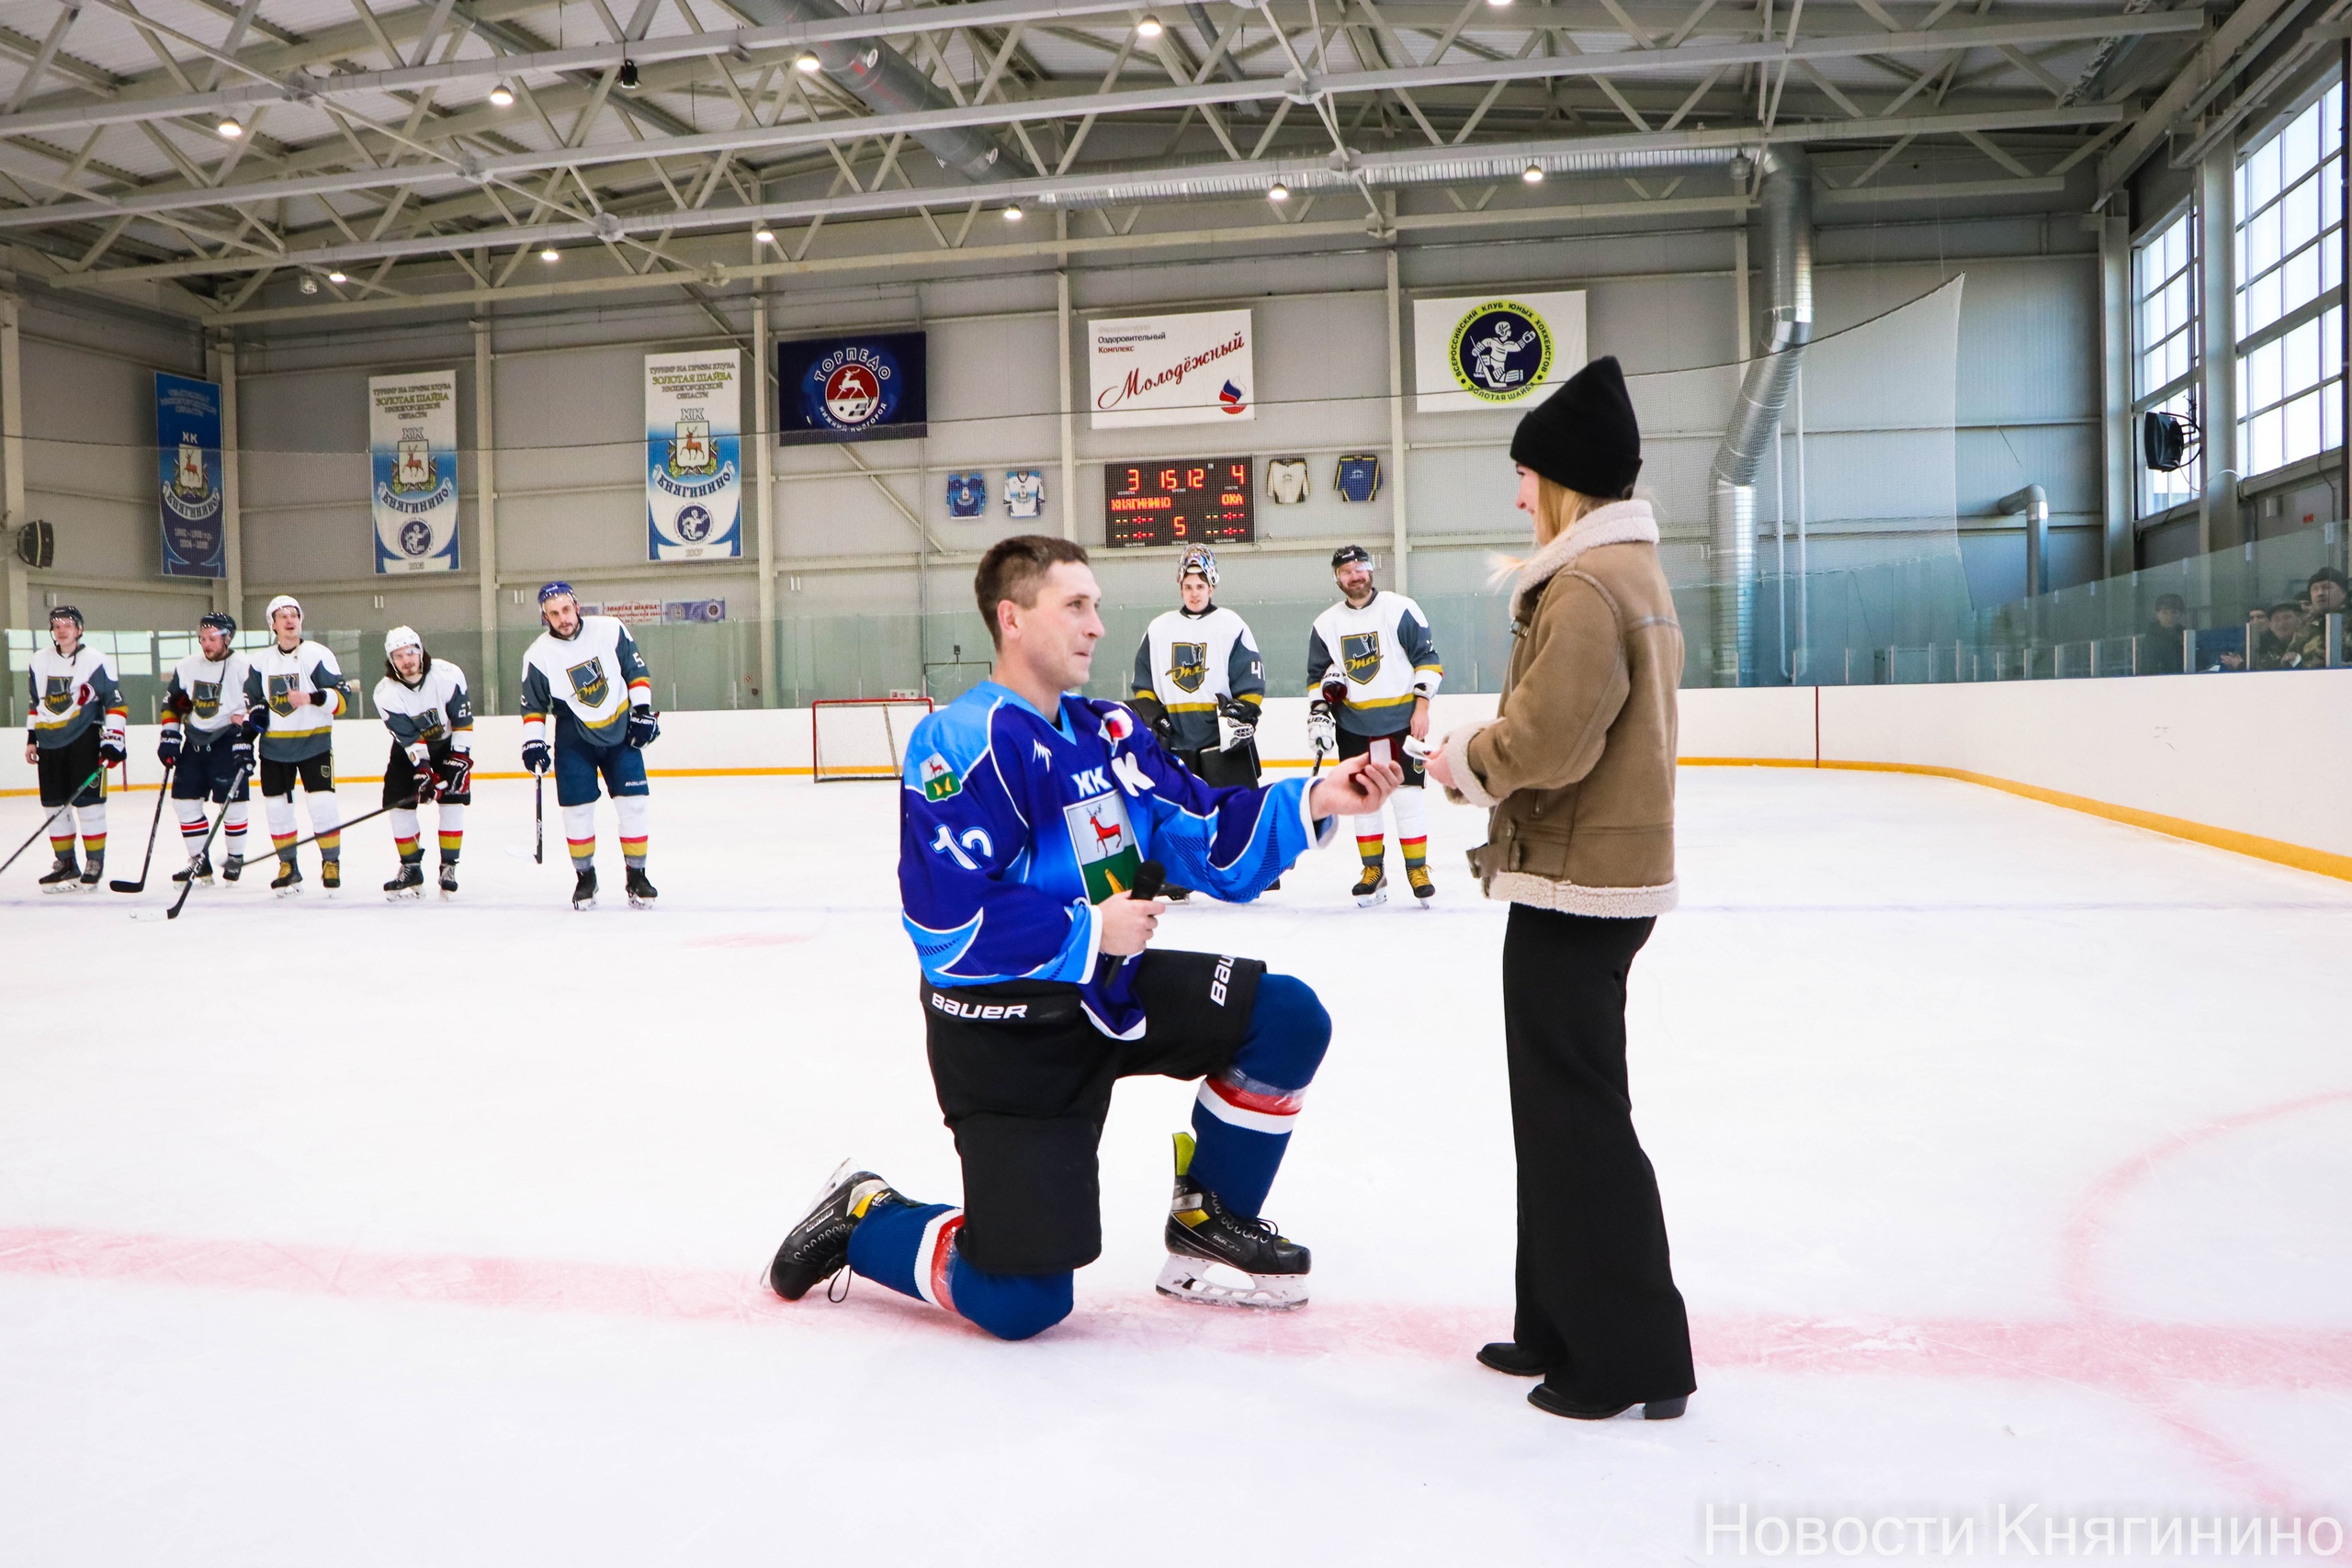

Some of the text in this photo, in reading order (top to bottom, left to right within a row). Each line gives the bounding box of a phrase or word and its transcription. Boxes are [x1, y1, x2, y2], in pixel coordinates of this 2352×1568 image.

[1098, 332, 1166, 344] Оздоровительный
[1451, 302, 1552, 378] ВСЕРОССИЙСКИЙ КЛУБ ЮНЫХ ХОККЕИСТОВ
[1098, 345, 1135, 355] Комплекс
[814, 347, 891, 382] ТОРПЕДО
[1097, 331, 1246, 410] Молодёжный
[1467, 381, 1534, 401] ЗОЛОТАЯ ШАЙБА
[681, 408, 705, 421] ХК
[819, 402, 888, 433] НИЖНИЙ НОВГОРОД
[182, 431, 198, 445] ХК
[402, 426, 424, 439] ХК
[657, 472, 730, 498] КНЯГИНИНО
[1127, 468, 1141, 492] 3
[1159, 468, 1205, 490] 15 12
[1230, 464, 1246, 486] 4
[381, 488, 449, 513] КНЯГИНИНО
[1111, 496, 1172, 512] КНЯГИНИНО
[1220, 492, 1245, 506] ОКА
[1172, 515, 1188, 537] 5
[1250, 660, 1266, 682] 41
[1070, 765, 1114, 799] ХК
